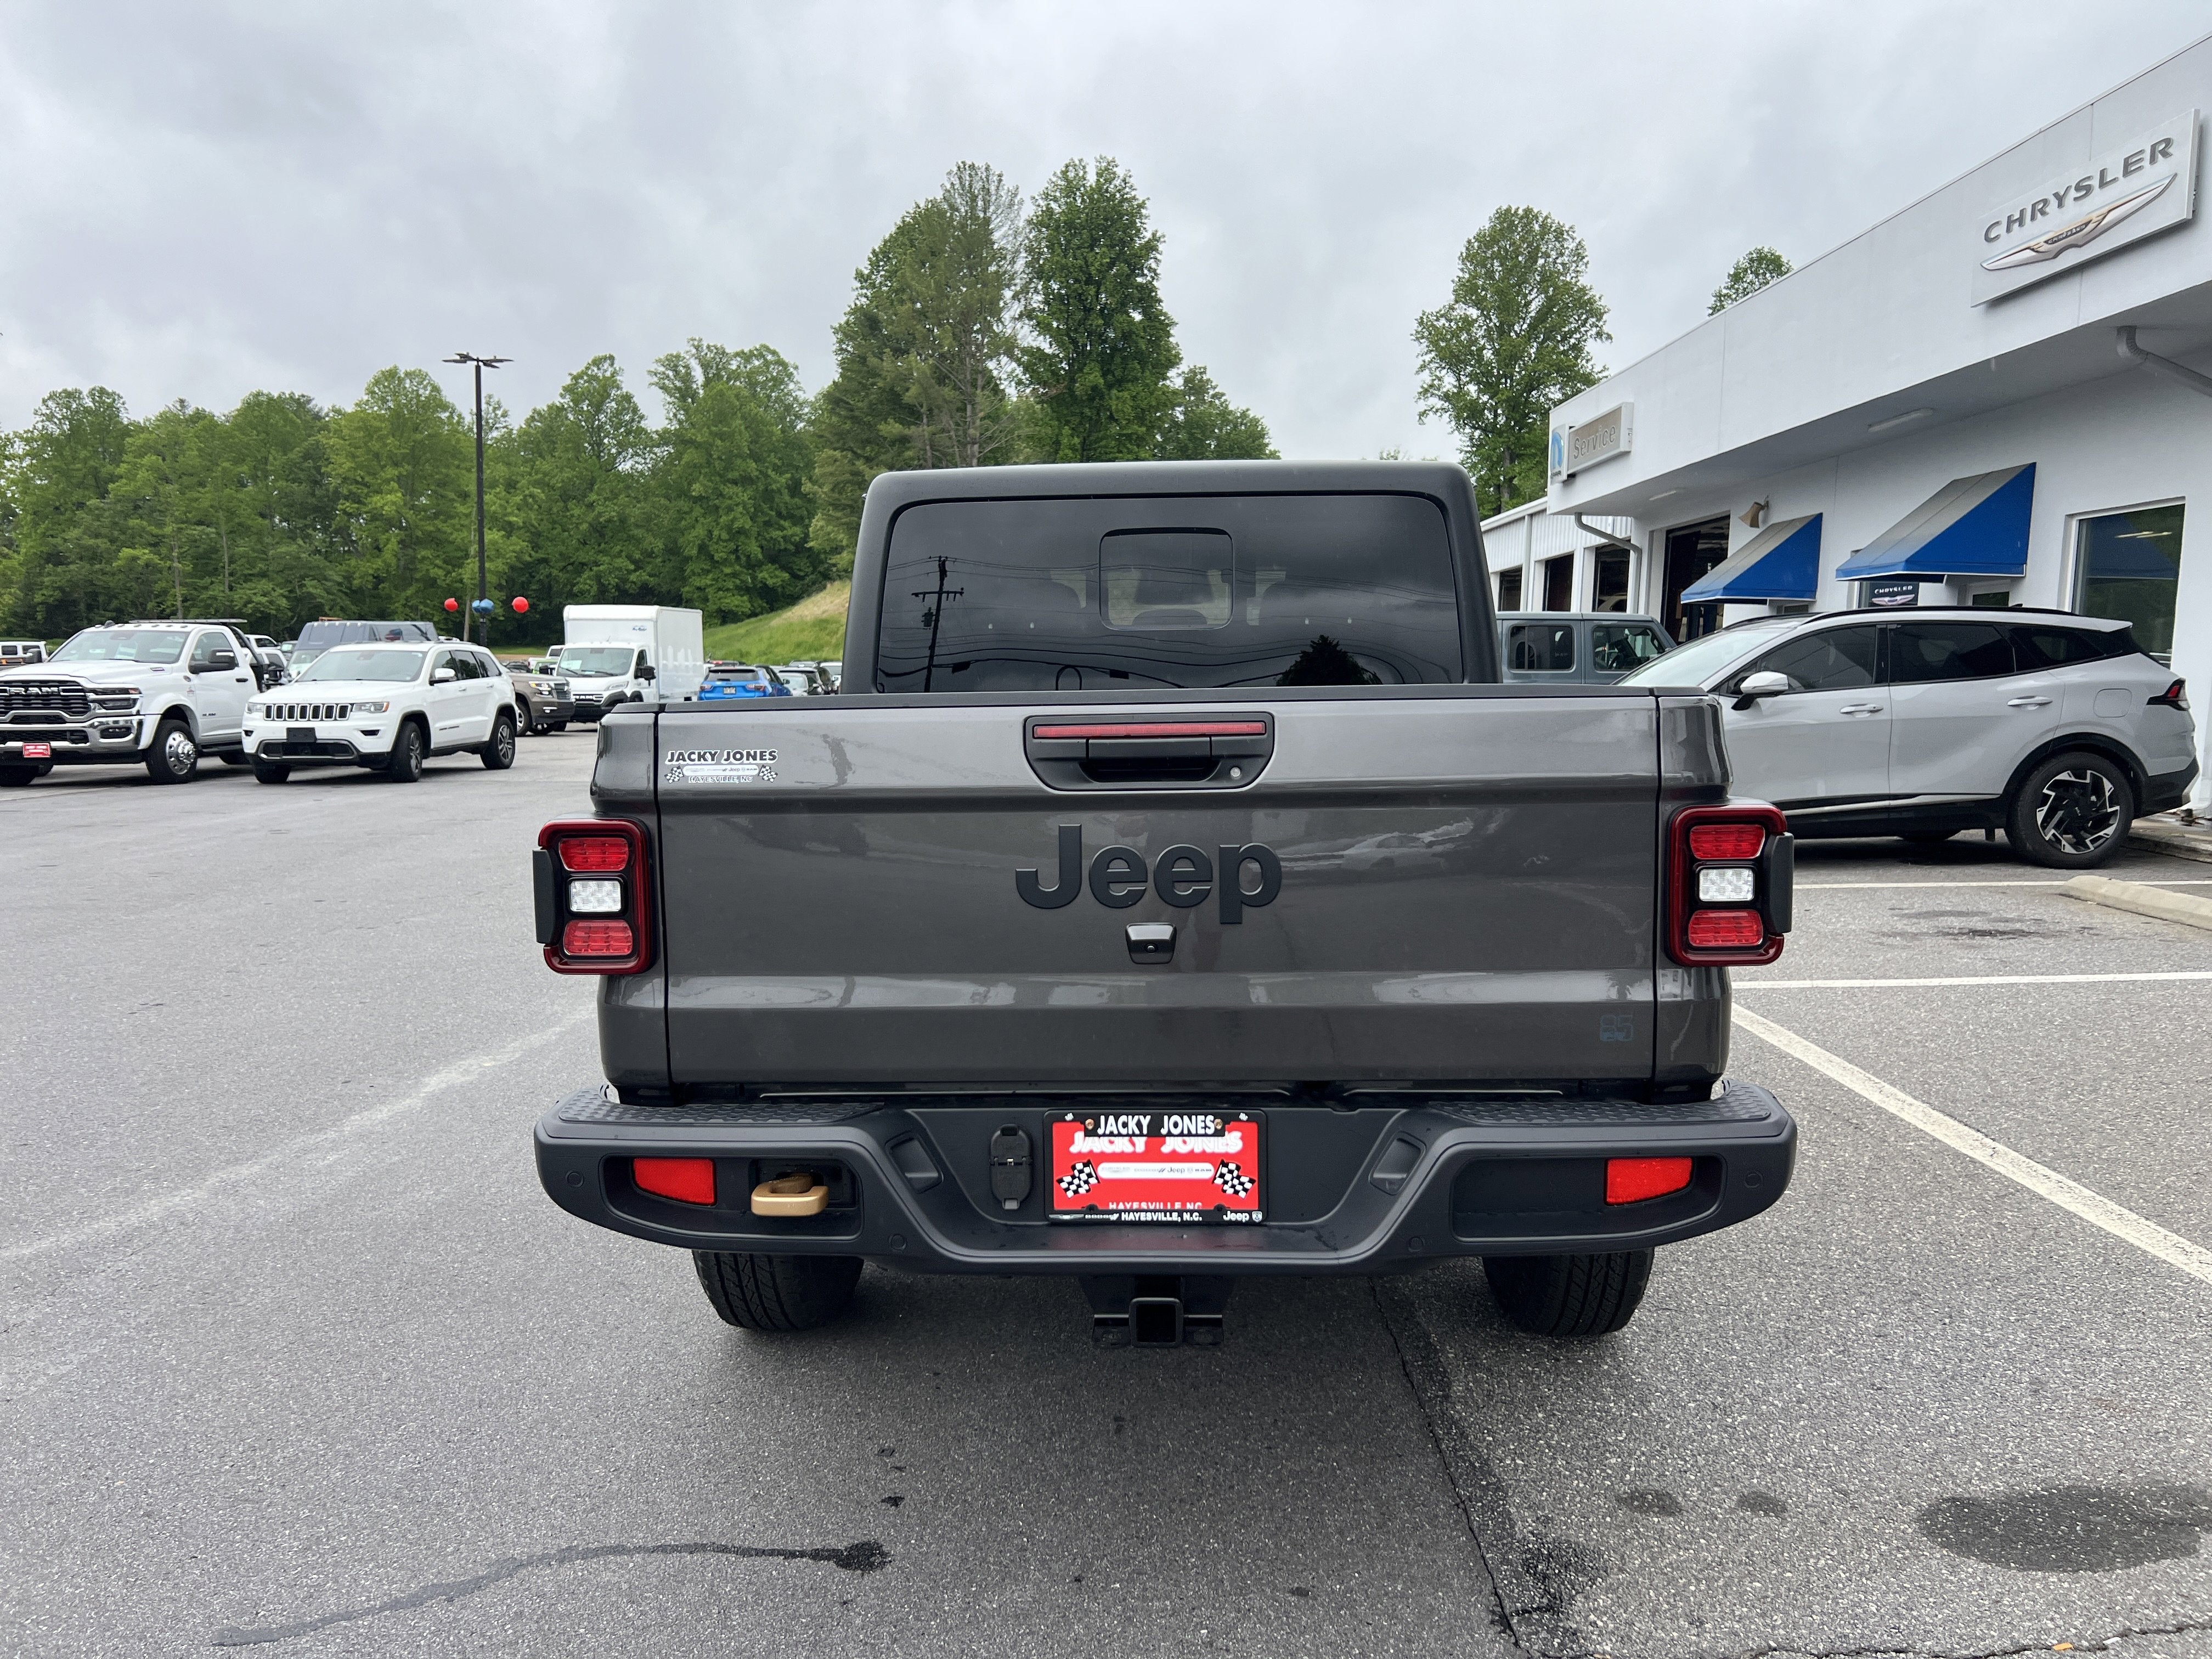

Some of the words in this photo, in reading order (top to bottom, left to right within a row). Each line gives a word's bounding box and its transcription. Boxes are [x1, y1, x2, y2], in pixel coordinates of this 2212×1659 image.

[1984, 137, 2174, 243] CHRYSLER
[1573, 425, 1616, 459] Service
[1875, 585, 1913, 594] CHRYSLER
[666, 750, 719, 763] JACKY
[723, 749, 778, 763] JONES
[1015, 823, 1282, 924] Jeep
[1097, 1115, 1151, 1135] JACKY
[1160, 1115, 1215, 1135] JONES
[1069, 1131, 1147, 1153] JACKY
[1160, 1131, 1243, 1153] JONES
[1121, 1211, 1181, 1222] HAYESVILLE,
[1183, 1211, 1203, 1221] N.C.
[1223, 1210, 1250, 1223] Jeep
